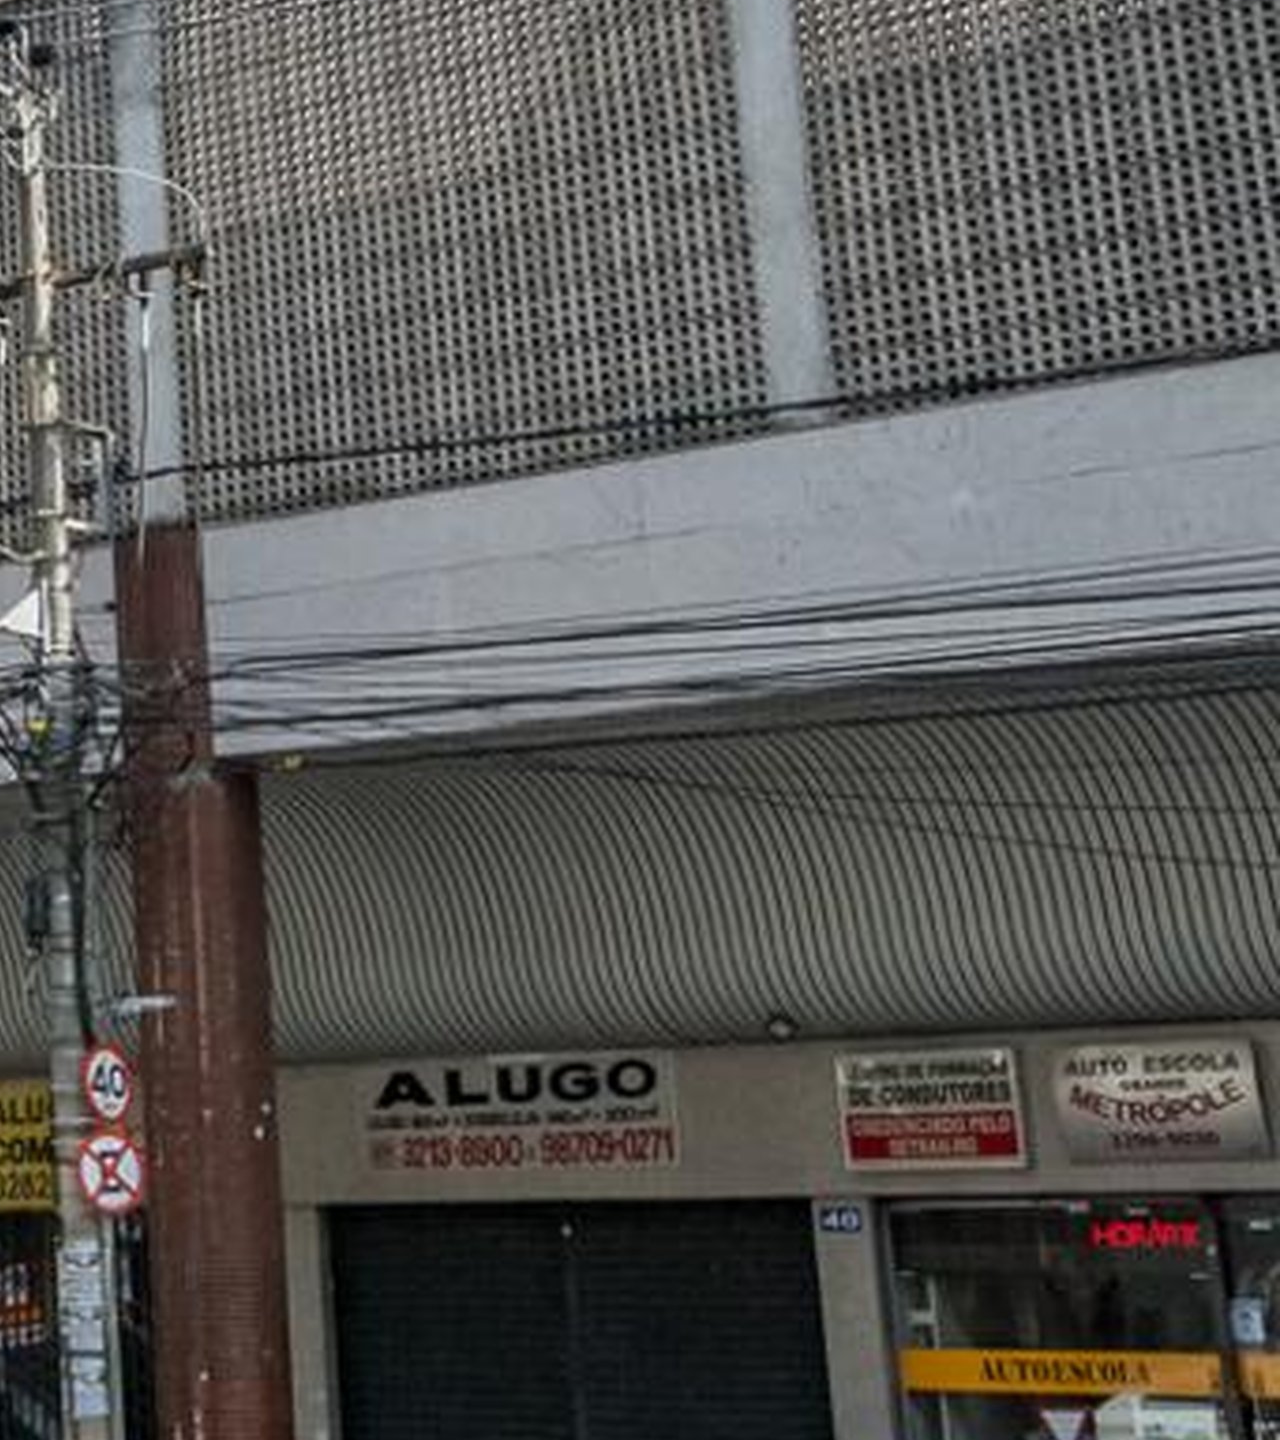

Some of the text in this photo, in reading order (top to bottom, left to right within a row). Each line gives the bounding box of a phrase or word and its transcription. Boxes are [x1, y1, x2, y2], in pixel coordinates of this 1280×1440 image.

[92, 1063, 127, 1098] 40
[1065, 1051, 1239, 1075] AUTO ESCOLA
[375, 1058, 657, 1109] ALUGO
[879, 1081, 1011, 1105] CONDUTORES
[1070, 1077, 1247, 1125] METRÓPOLE
